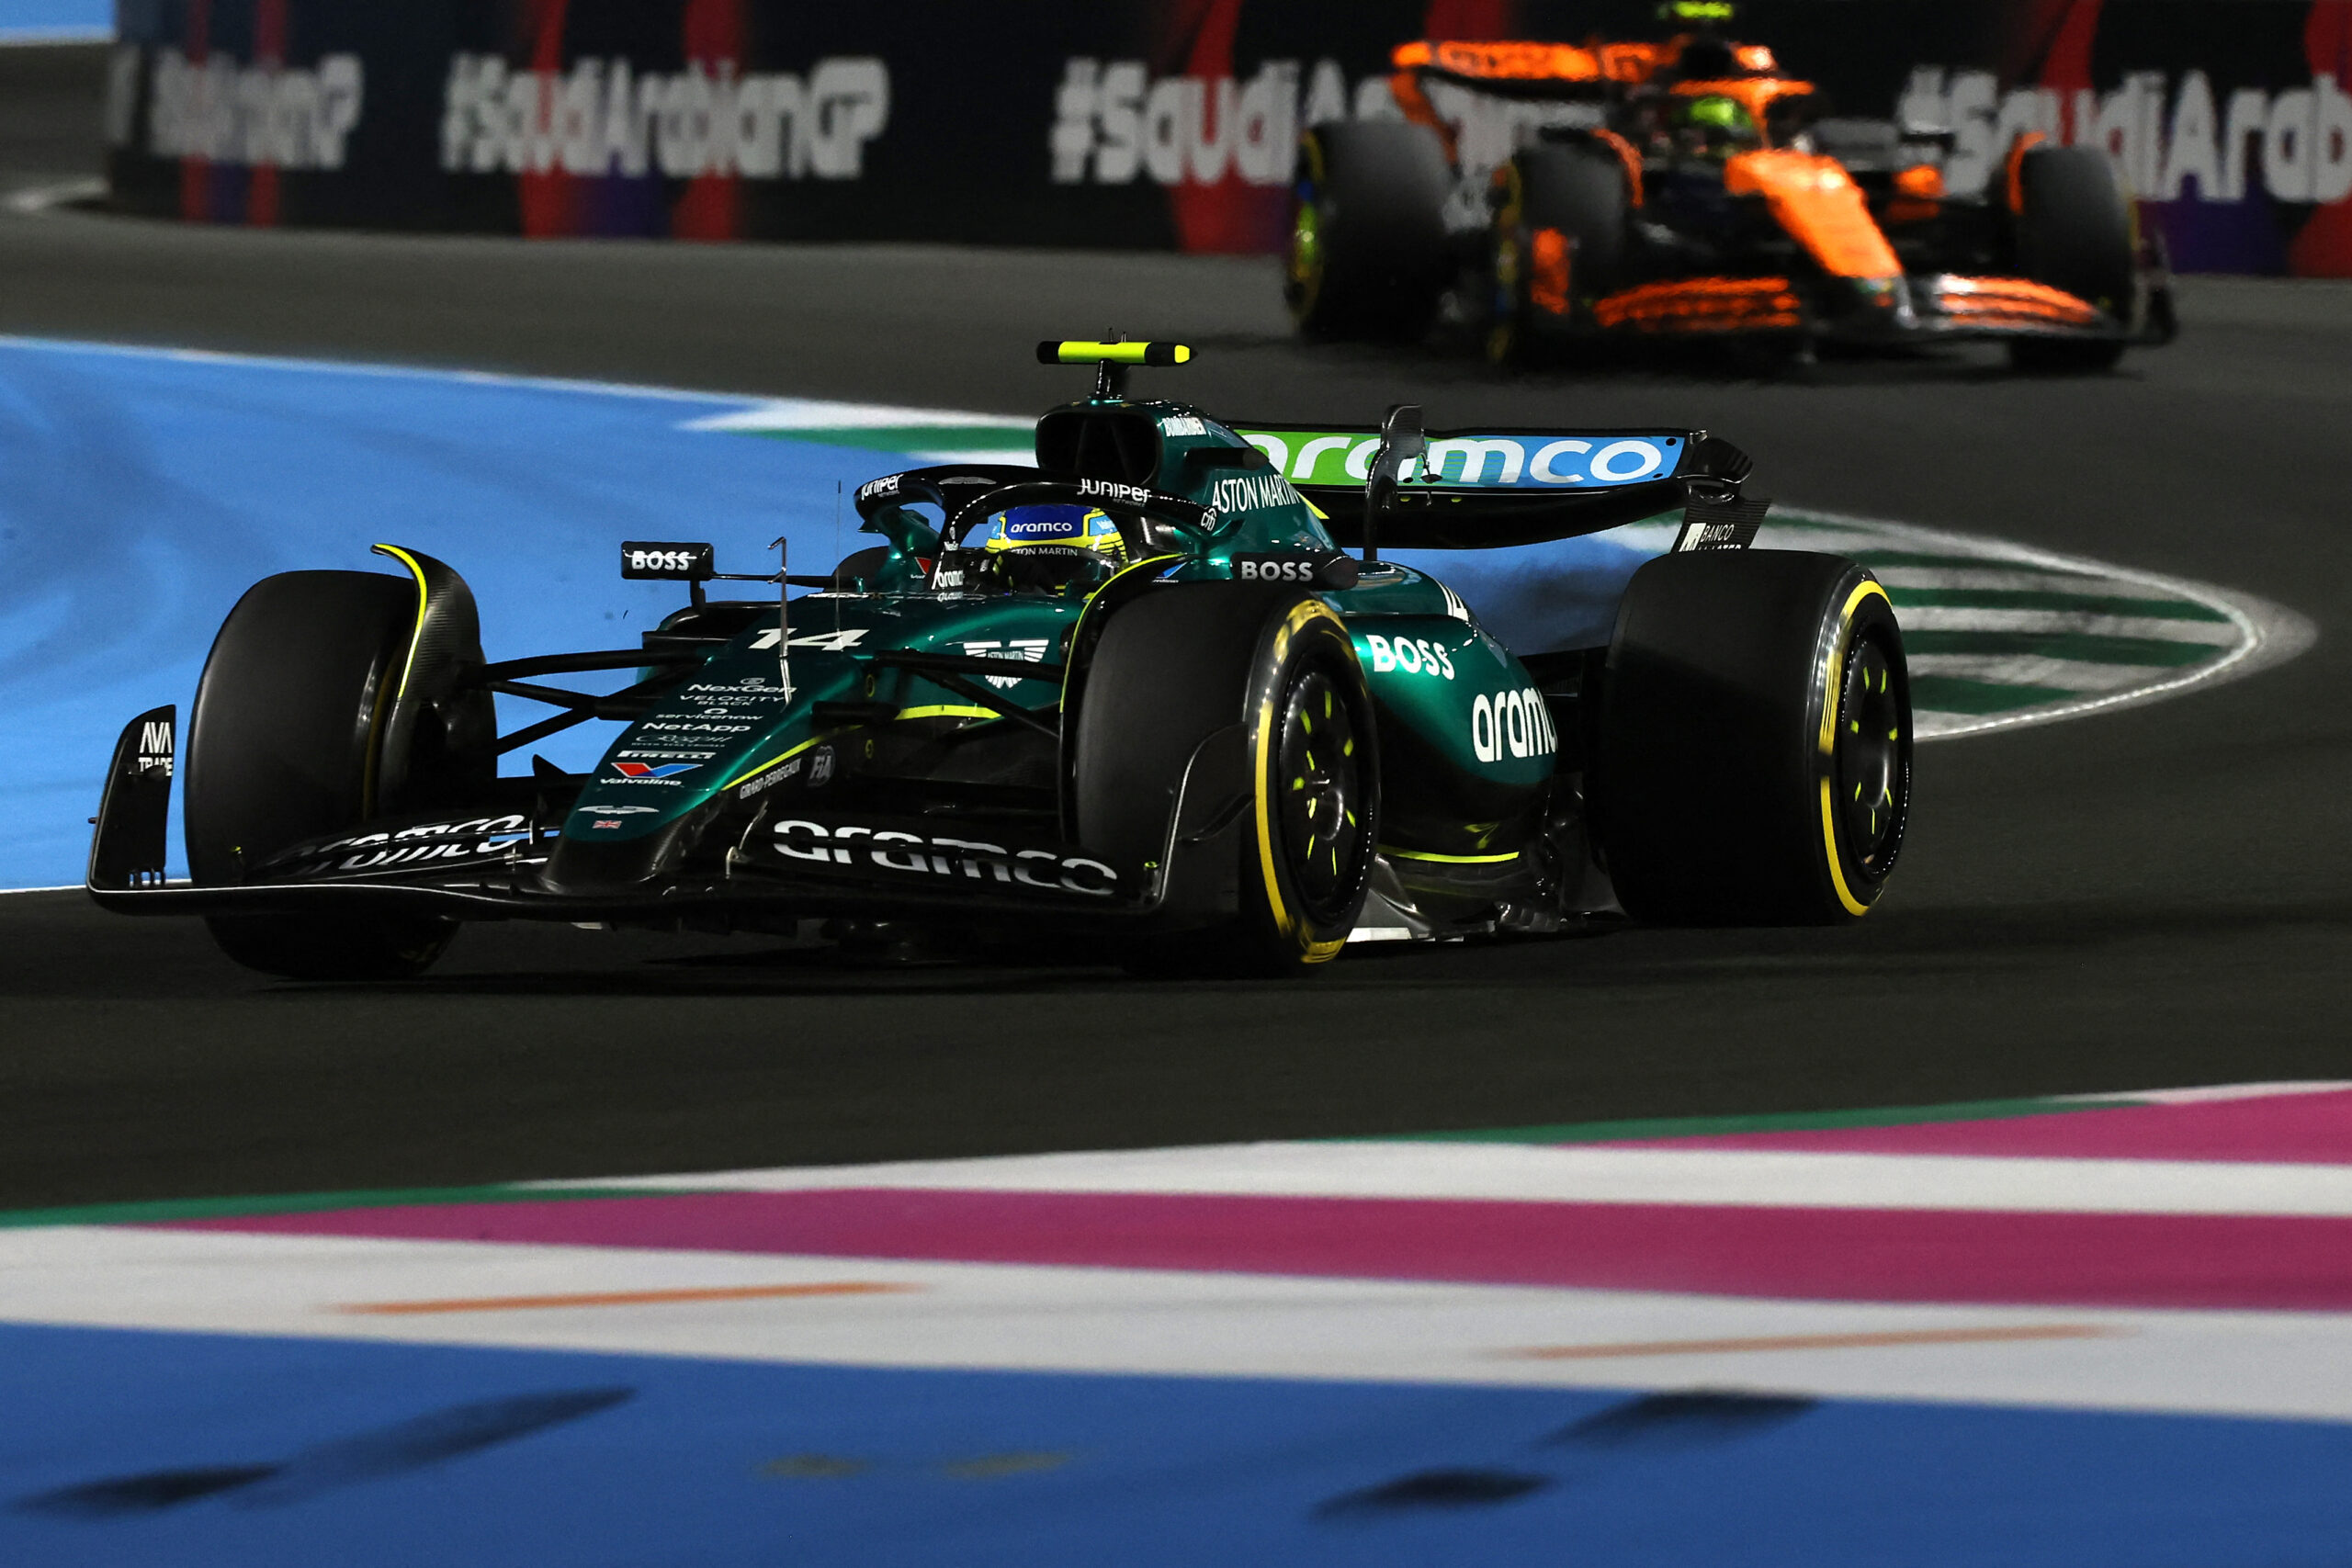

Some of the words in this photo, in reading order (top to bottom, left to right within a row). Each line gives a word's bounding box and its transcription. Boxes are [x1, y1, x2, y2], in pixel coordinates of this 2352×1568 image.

[1212, 478, 1259, 513] ASTON
[1011, 522, 1072, 533] aramco
[1700, 524, 1735, 543] BANCO
[631, 550, 689, 570] BOSS
[1038, 547, 1078, 557] MARTIN
[1241, 561, 1314, 581] BOSS
[749, 627, 869, 650] 14
[1366, 634, 1455, 681] BOSS
[139, 721, 173, 754] AVA
[641, 722, 752, 733] NetApp
[616, 750, 717, 760] PIRELLI
[600, 777, 683, 787] Valvoline
[774, 819, 1118, 896] aramco
